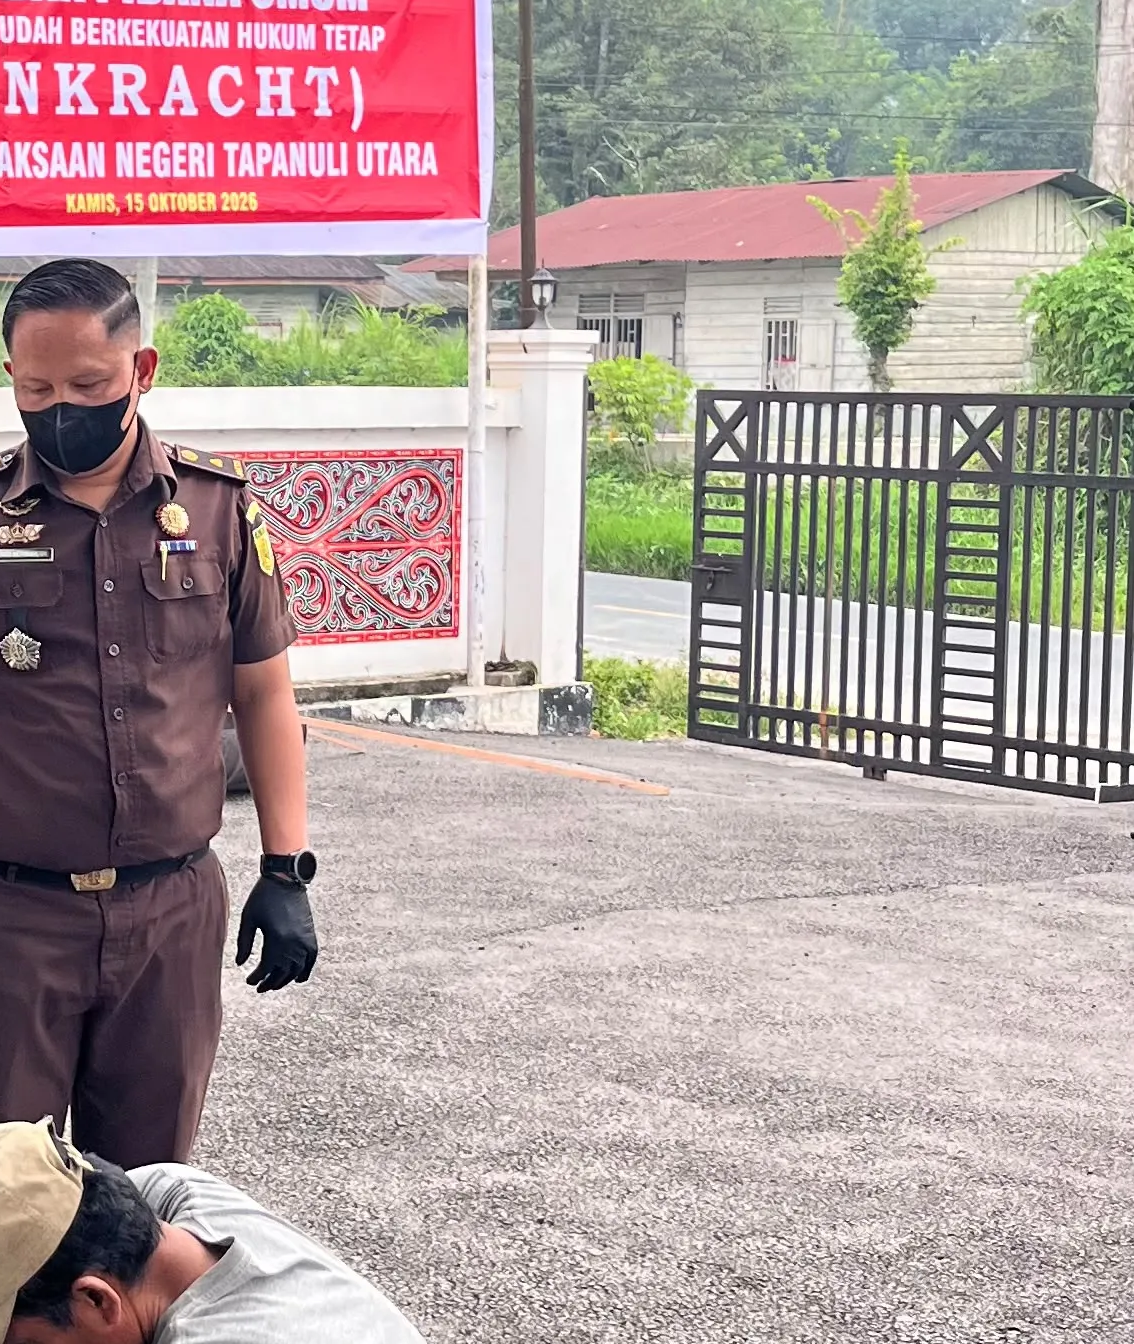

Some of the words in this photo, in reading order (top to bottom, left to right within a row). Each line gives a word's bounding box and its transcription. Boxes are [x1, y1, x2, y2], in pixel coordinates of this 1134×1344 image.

[71, 18, 229, 48] BERKEKUATAN
[238, 22, 315, 50] HUKUM
[323, 24, 385, 51] TETAP
[116, 142, 214, 178] NEGERI
[223, 142, 348, 177] TAPANULI
[358, 142, 438, 176] UTARA
[66, 193, 119, 215] KAMIS,
[125, 193, 144, 212] 15
[148, 192, 216, 212] OKTOBER
